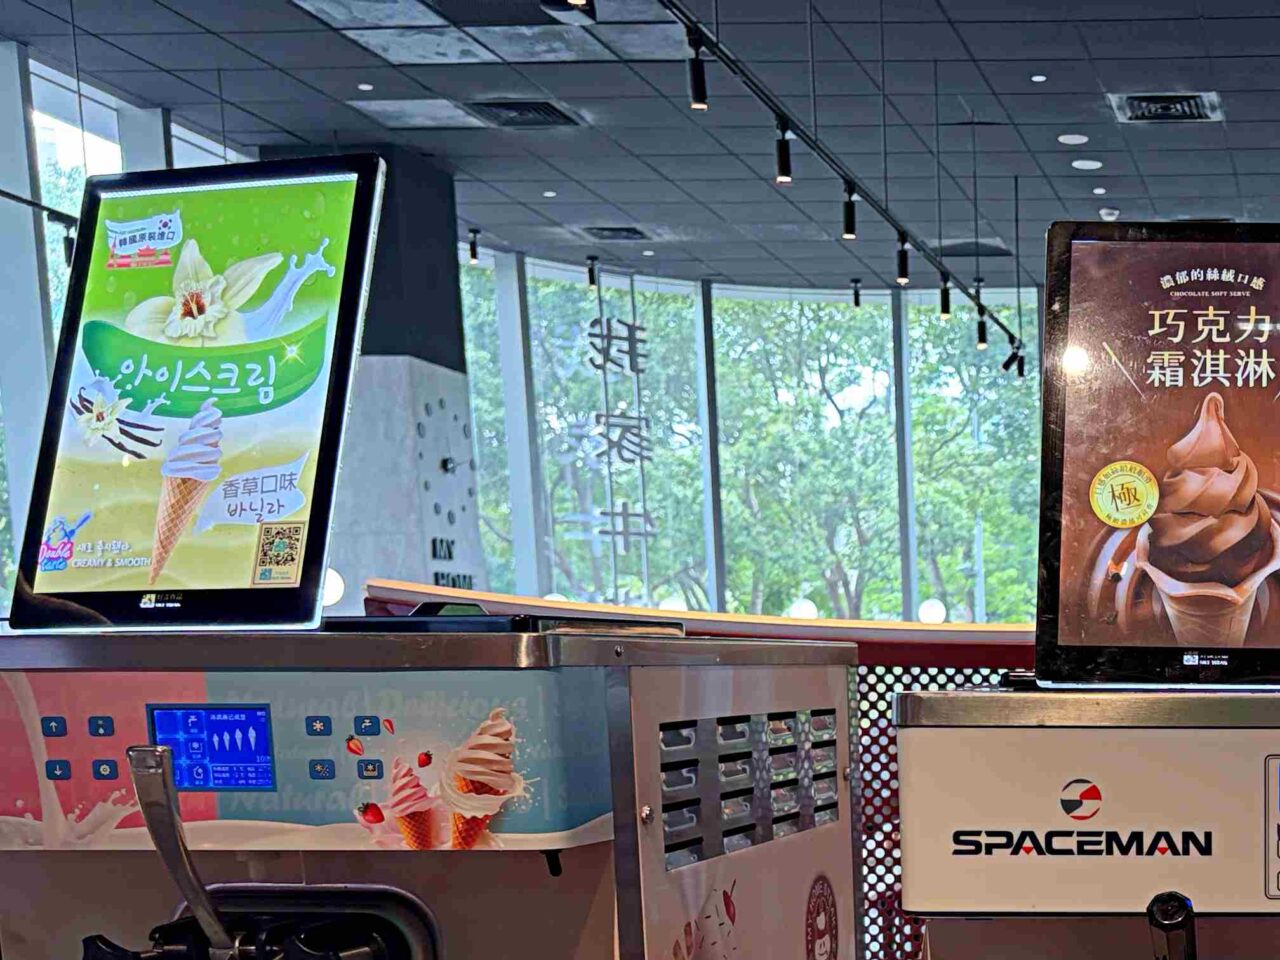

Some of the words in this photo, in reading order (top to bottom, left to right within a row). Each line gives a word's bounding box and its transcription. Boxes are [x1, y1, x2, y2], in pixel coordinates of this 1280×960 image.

[1148, 305, 1271, 343] 巧克力
[121, 354, 276, 404] 아이스크림
[1146, 348, 1276, 388] 霜淇淋
[222, 472, 298, 499] 香草口味
[227, 498, 285, 523] 바닐라
[432, 538, 455, 560] MY
[72, 559, 104, 568] CREAMY
[116, 558, 151, 568] SMOOTH
[951, 830, 1212, 856] SPACEMAN
